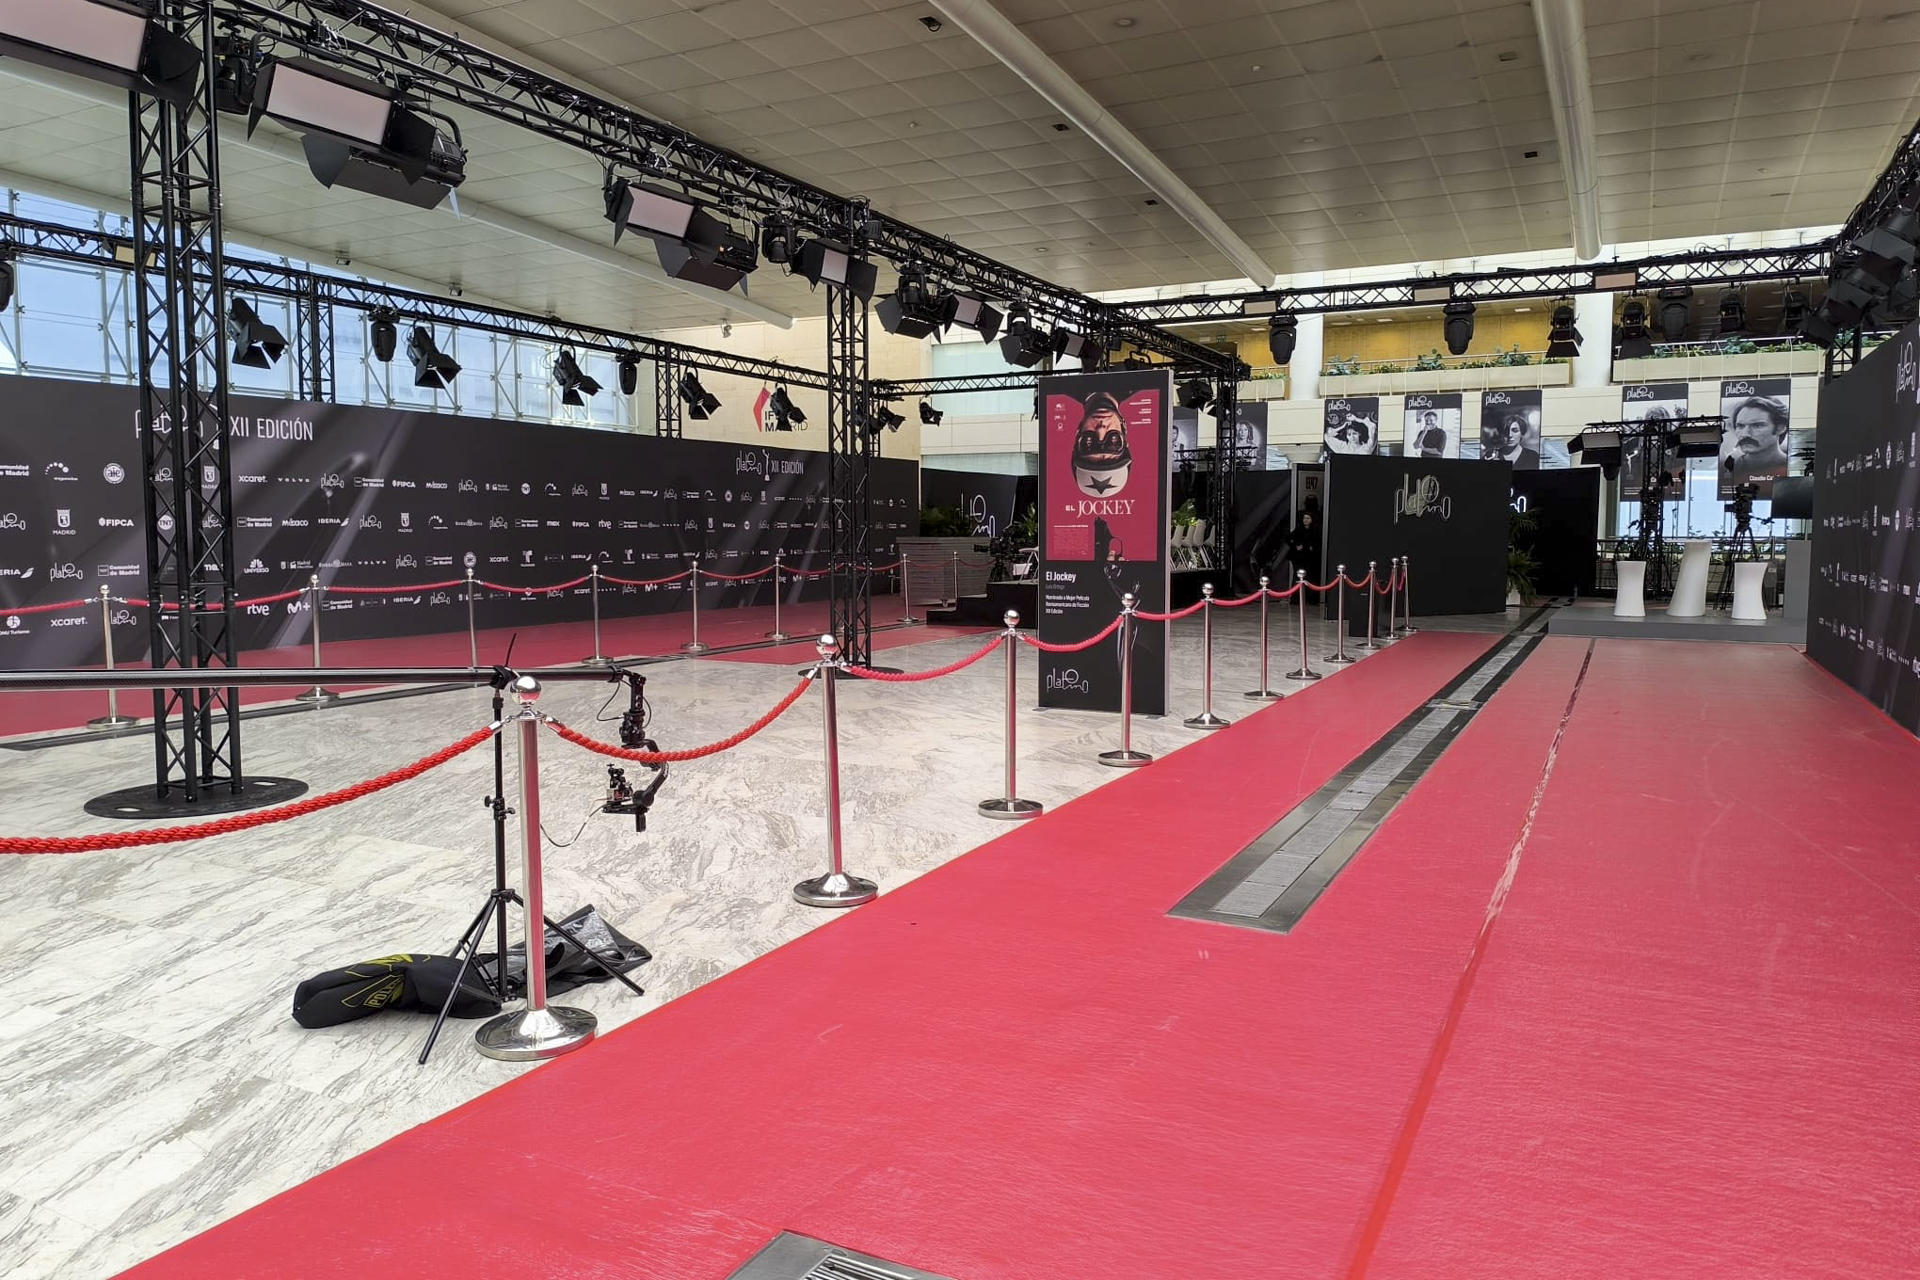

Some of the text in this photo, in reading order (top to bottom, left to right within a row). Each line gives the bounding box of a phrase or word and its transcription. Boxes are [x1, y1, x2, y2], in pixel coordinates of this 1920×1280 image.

[230, 416, 313, 441] XII EDICIÓN
[781, 460, 804, 475] EDICIÓN
[1394, 473, 1451, 525] platino
[1077, 500, 1135, 518] JOCKEY
[106, 519, 134, 527] FIPCA
[50, 562, 83, 582] platino
[1046, 571, 1076, 583] El Jockey
[247, 604, 269, 616] rtve
[1046, 667, 1088, 694] platino
